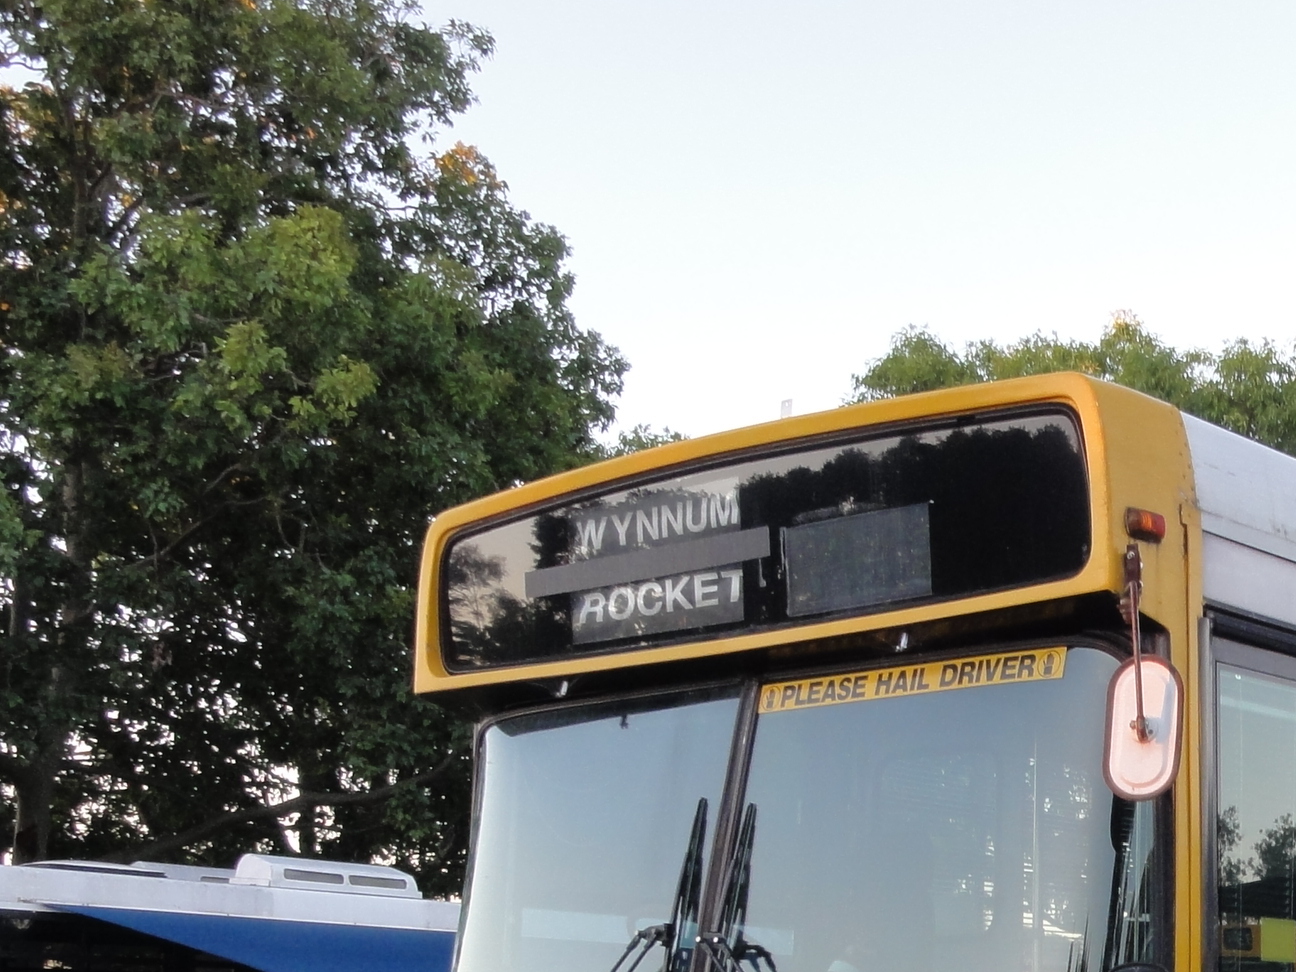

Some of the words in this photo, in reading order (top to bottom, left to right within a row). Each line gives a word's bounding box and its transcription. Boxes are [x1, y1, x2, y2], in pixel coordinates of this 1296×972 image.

[577, 493, 740, 550] WYNNUM
[578, 569, 744, 624] ROCKET
[780, 674, 869, 707] PLEASE
[874, 667, 930, 696] HAIL
[938, 654, 1038, 688] DRIVER
